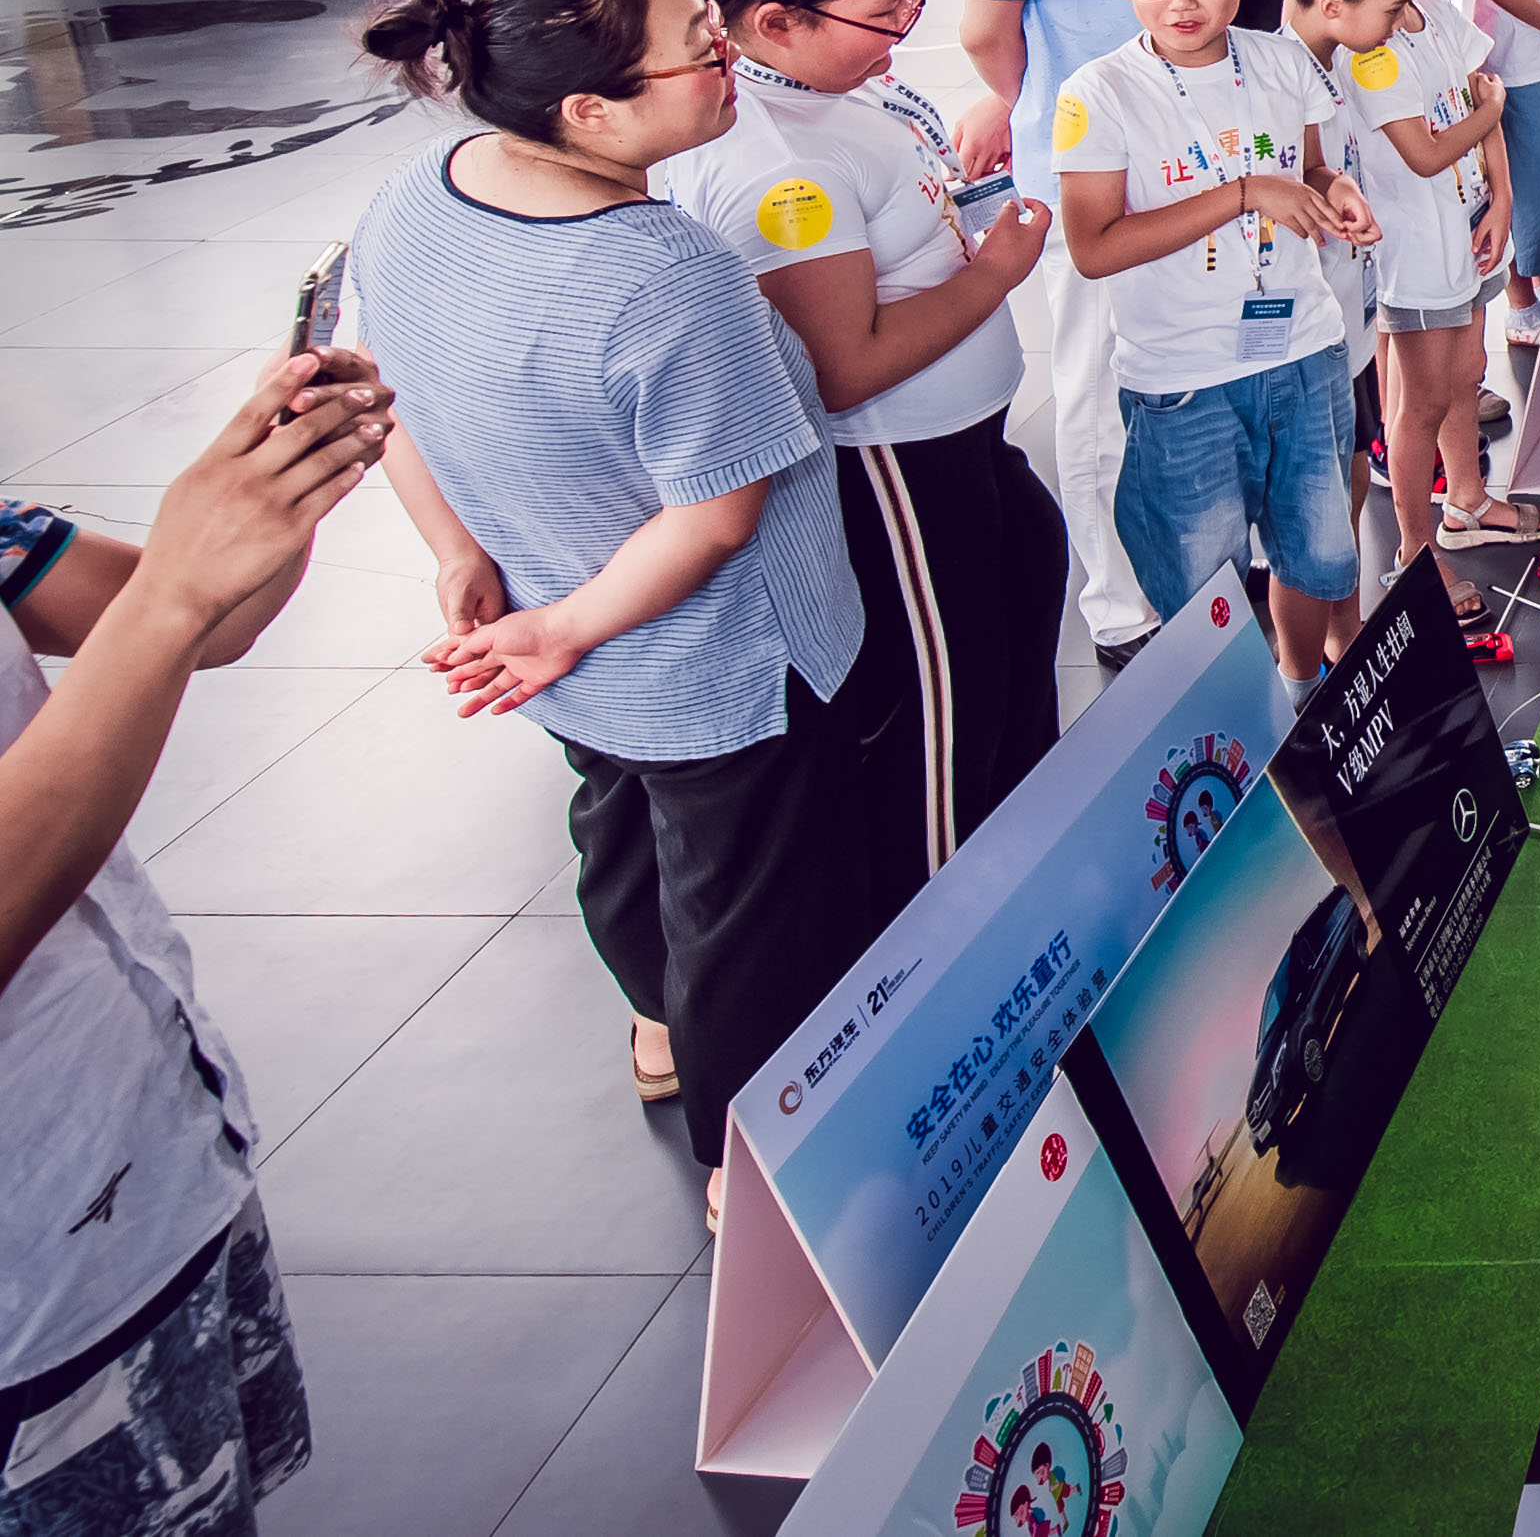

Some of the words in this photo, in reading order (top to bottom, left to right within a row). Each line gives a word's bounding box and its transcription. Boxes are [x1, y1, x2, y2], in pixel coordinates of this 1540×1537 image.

[1320, 610, 1416, 761] 大，方显人生壮阔
[1336, 698, 1395, 797] V级MPV
[803, 1017, 858, 1085] 东方汽车
[866, 982, 890, 1017] 21
[905, 1035, 994, 1150] 安全在心
[991, 928, 1073, 1039] 欢乐童行
[921, 1142, 941, 1167] KEEP
[938, 1110, 965, 1145] SAFETY
[970, 1080, 990, 1107] MIND
[989, 1050, 1011, 1080] ENJOY
[1019, 993, 1054, 1039] PLEASURE
[1050, 957, 1082, 1002] TOGETHER
[914, 965, 1110, 1228] 2019儿童交通安全体验营
[926, 1176, 976, 1244] CHILDREN'S
[972, 1137, 1006, 1181] TRAFFIC
[1003, 1103, 1032, 1143] SAFETY
